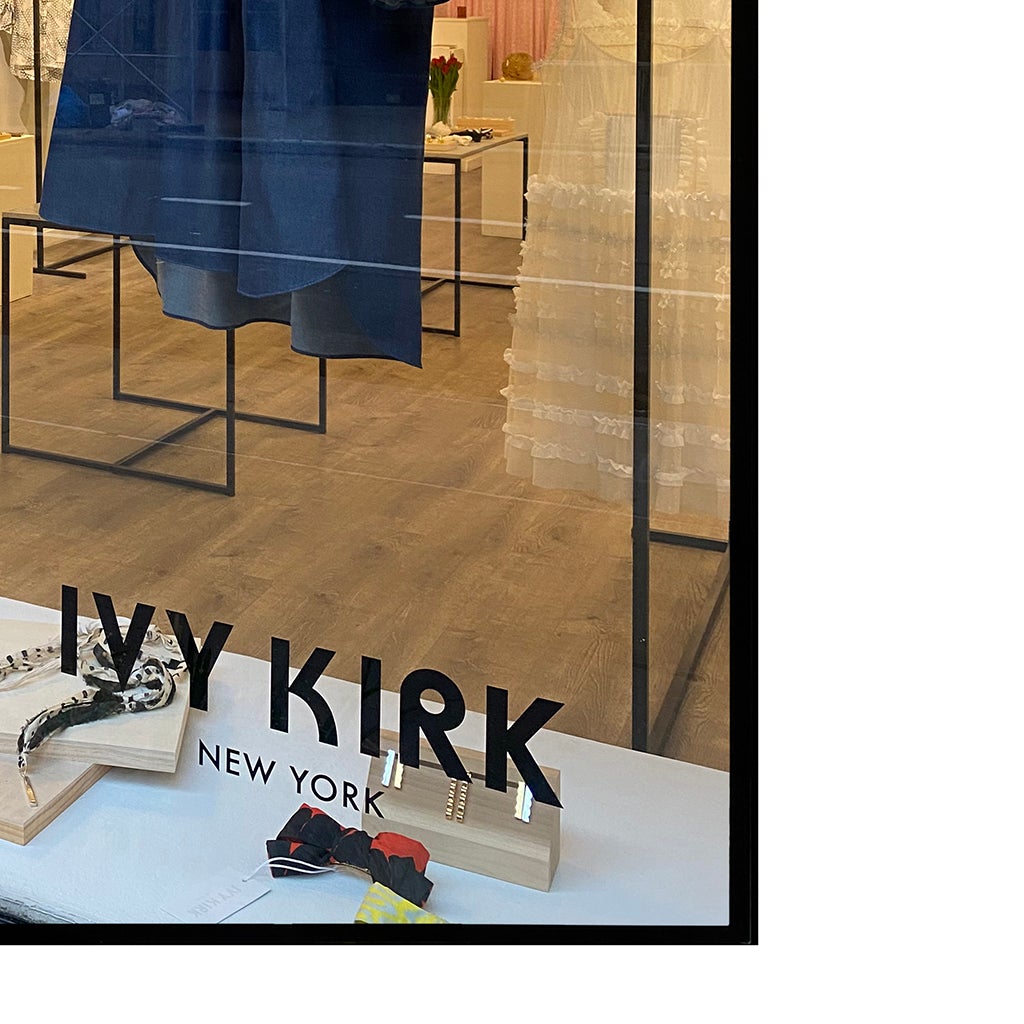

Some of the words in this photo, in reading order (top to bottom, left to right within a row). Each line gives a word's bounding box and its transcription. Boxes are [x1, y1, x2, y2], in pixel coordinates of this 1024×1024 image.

[60, 584, 234, 712] IVY
[270, 636, 565, 809] KIRK
[197, 739, 277, 786] NEW
[289, 765, 386, 819] YORK
